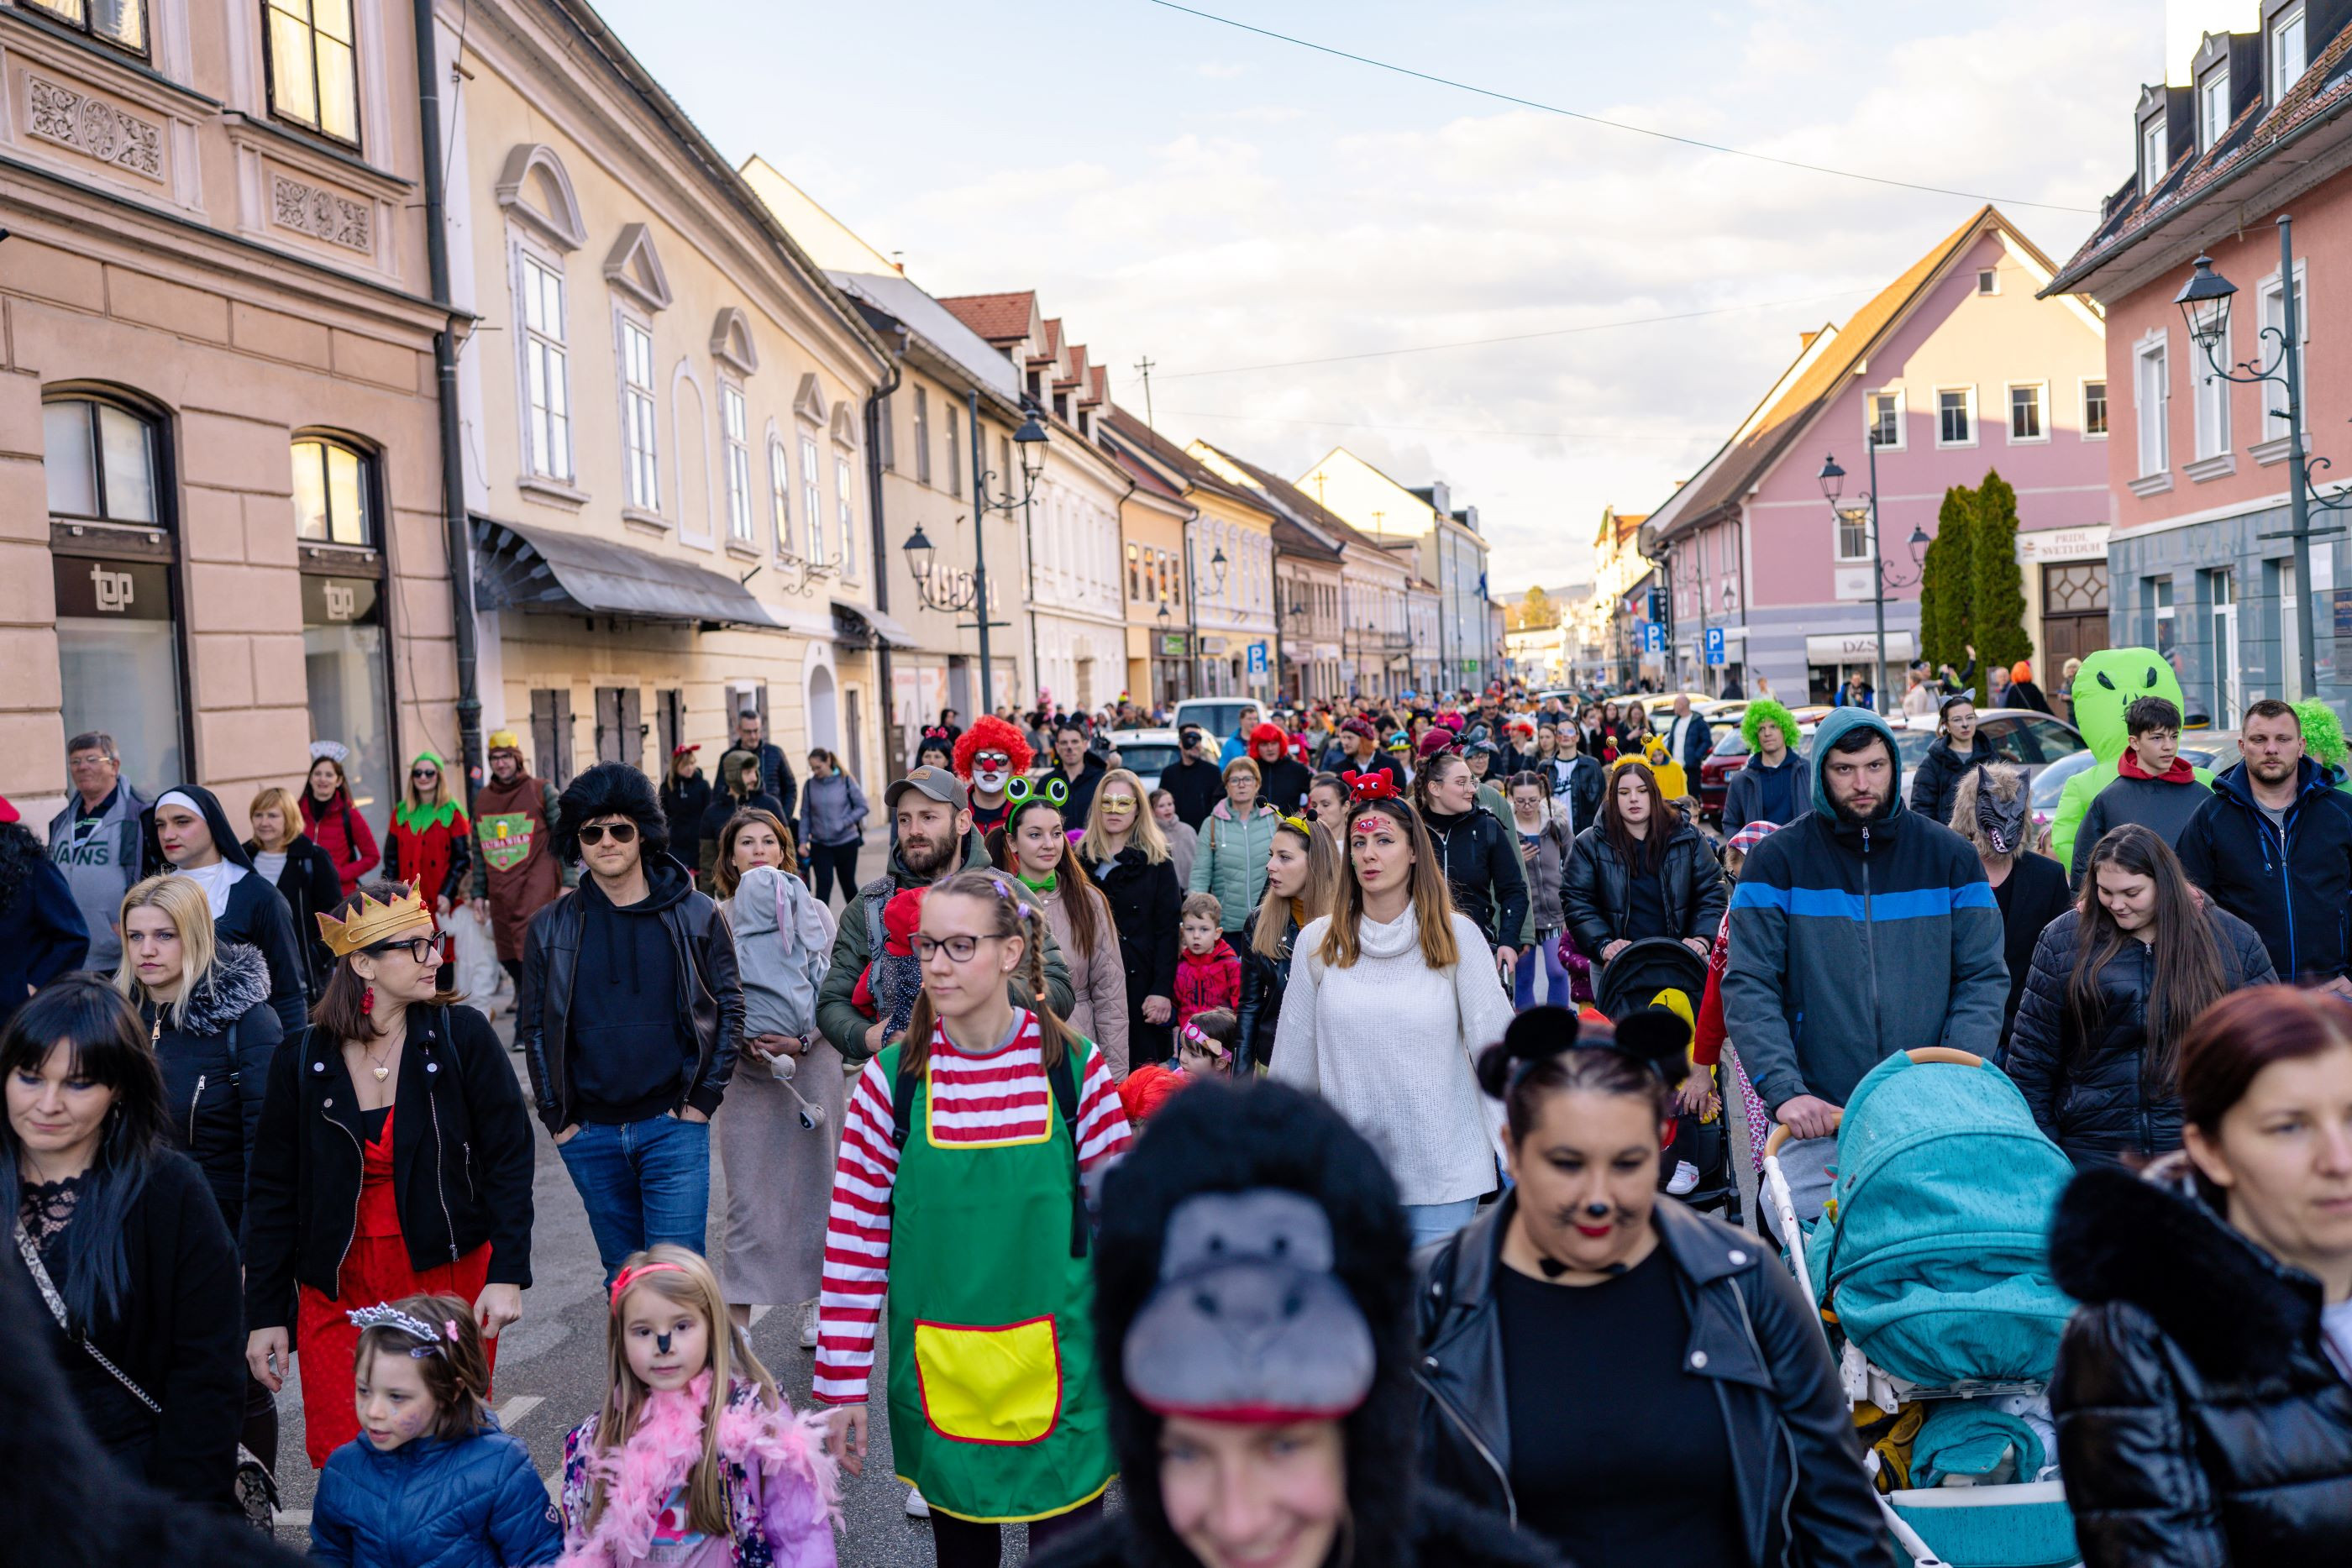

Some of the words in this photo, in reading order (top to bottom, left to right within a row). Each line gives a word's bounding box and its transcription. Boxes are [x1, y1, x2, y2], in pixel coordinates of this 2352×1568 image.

[1648, 625, 1660, 641] P
[1709, 630, 1720, 649] P
[53, 841, 108, 866] VANS
